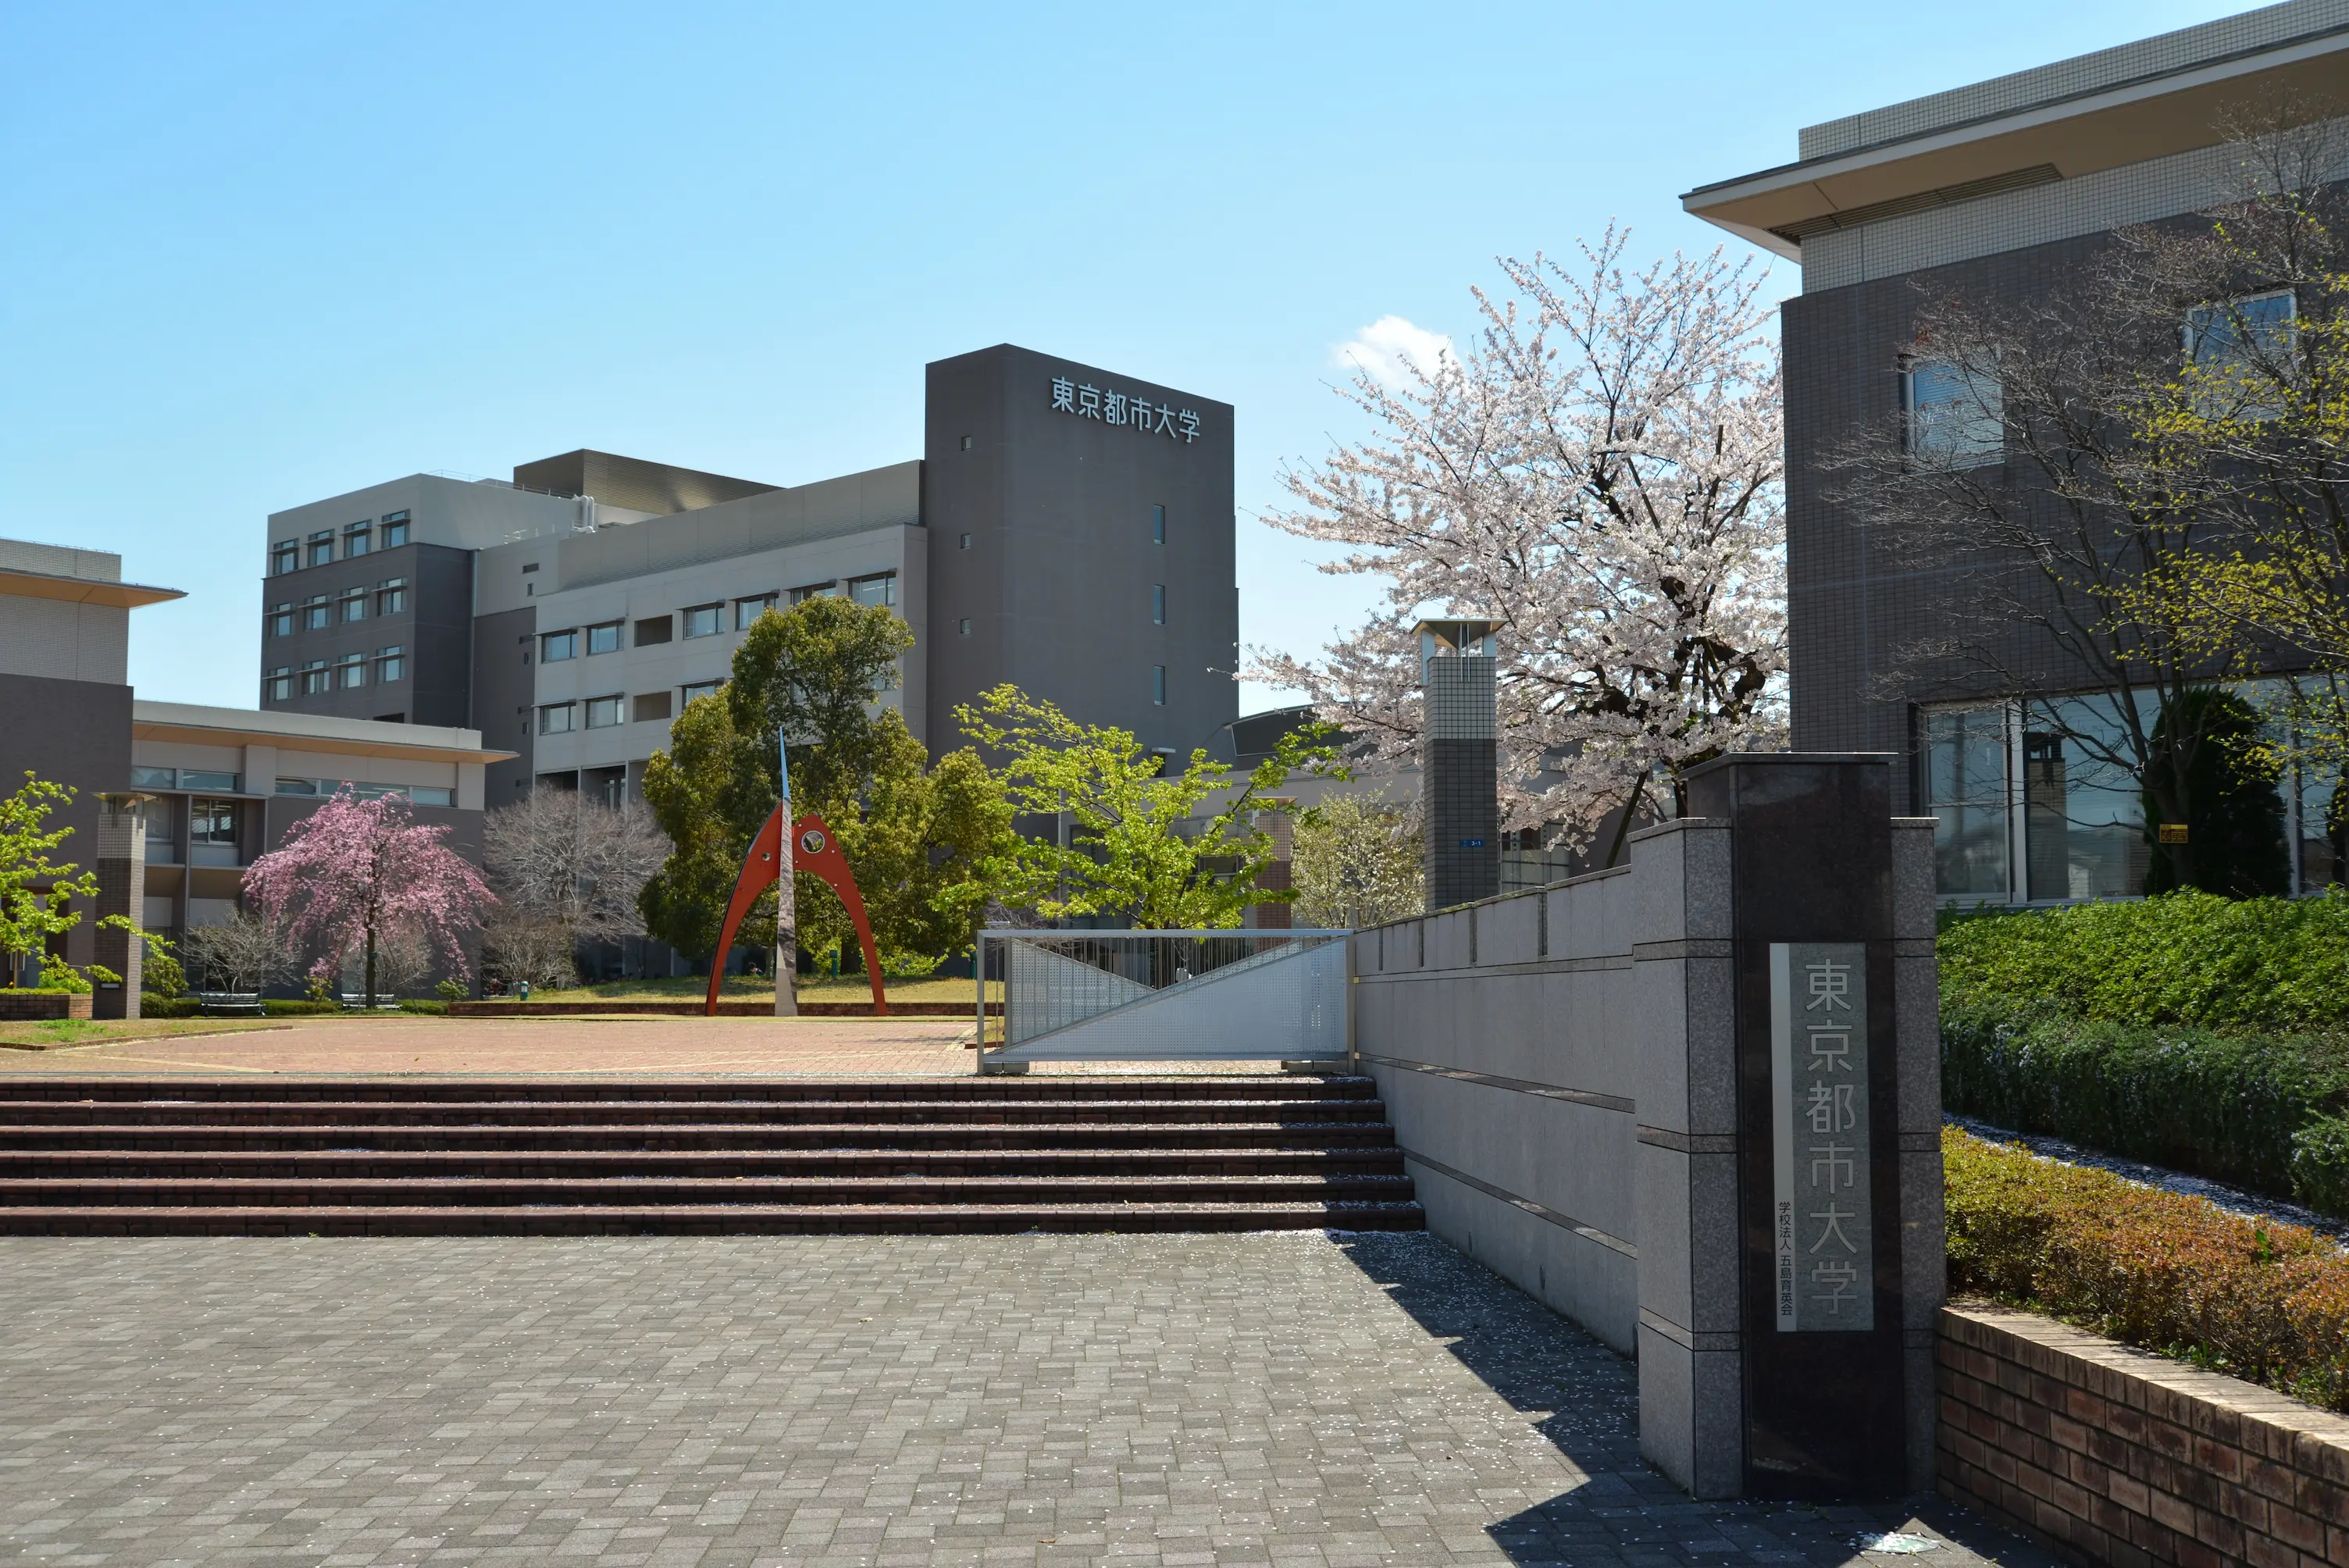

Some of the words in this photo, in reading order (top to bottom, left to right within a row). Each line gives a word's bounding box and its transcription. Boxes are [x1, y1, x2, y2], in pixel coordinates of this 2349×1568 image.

[1051, 376, 1200, 444] 東京都市大学
[1805, 958, 1858, 1315] 東京都市大学
[1779, 1201, 1792, 1251] 学校法人
[1780, 1255, 1793, 1316] 五島育英会
